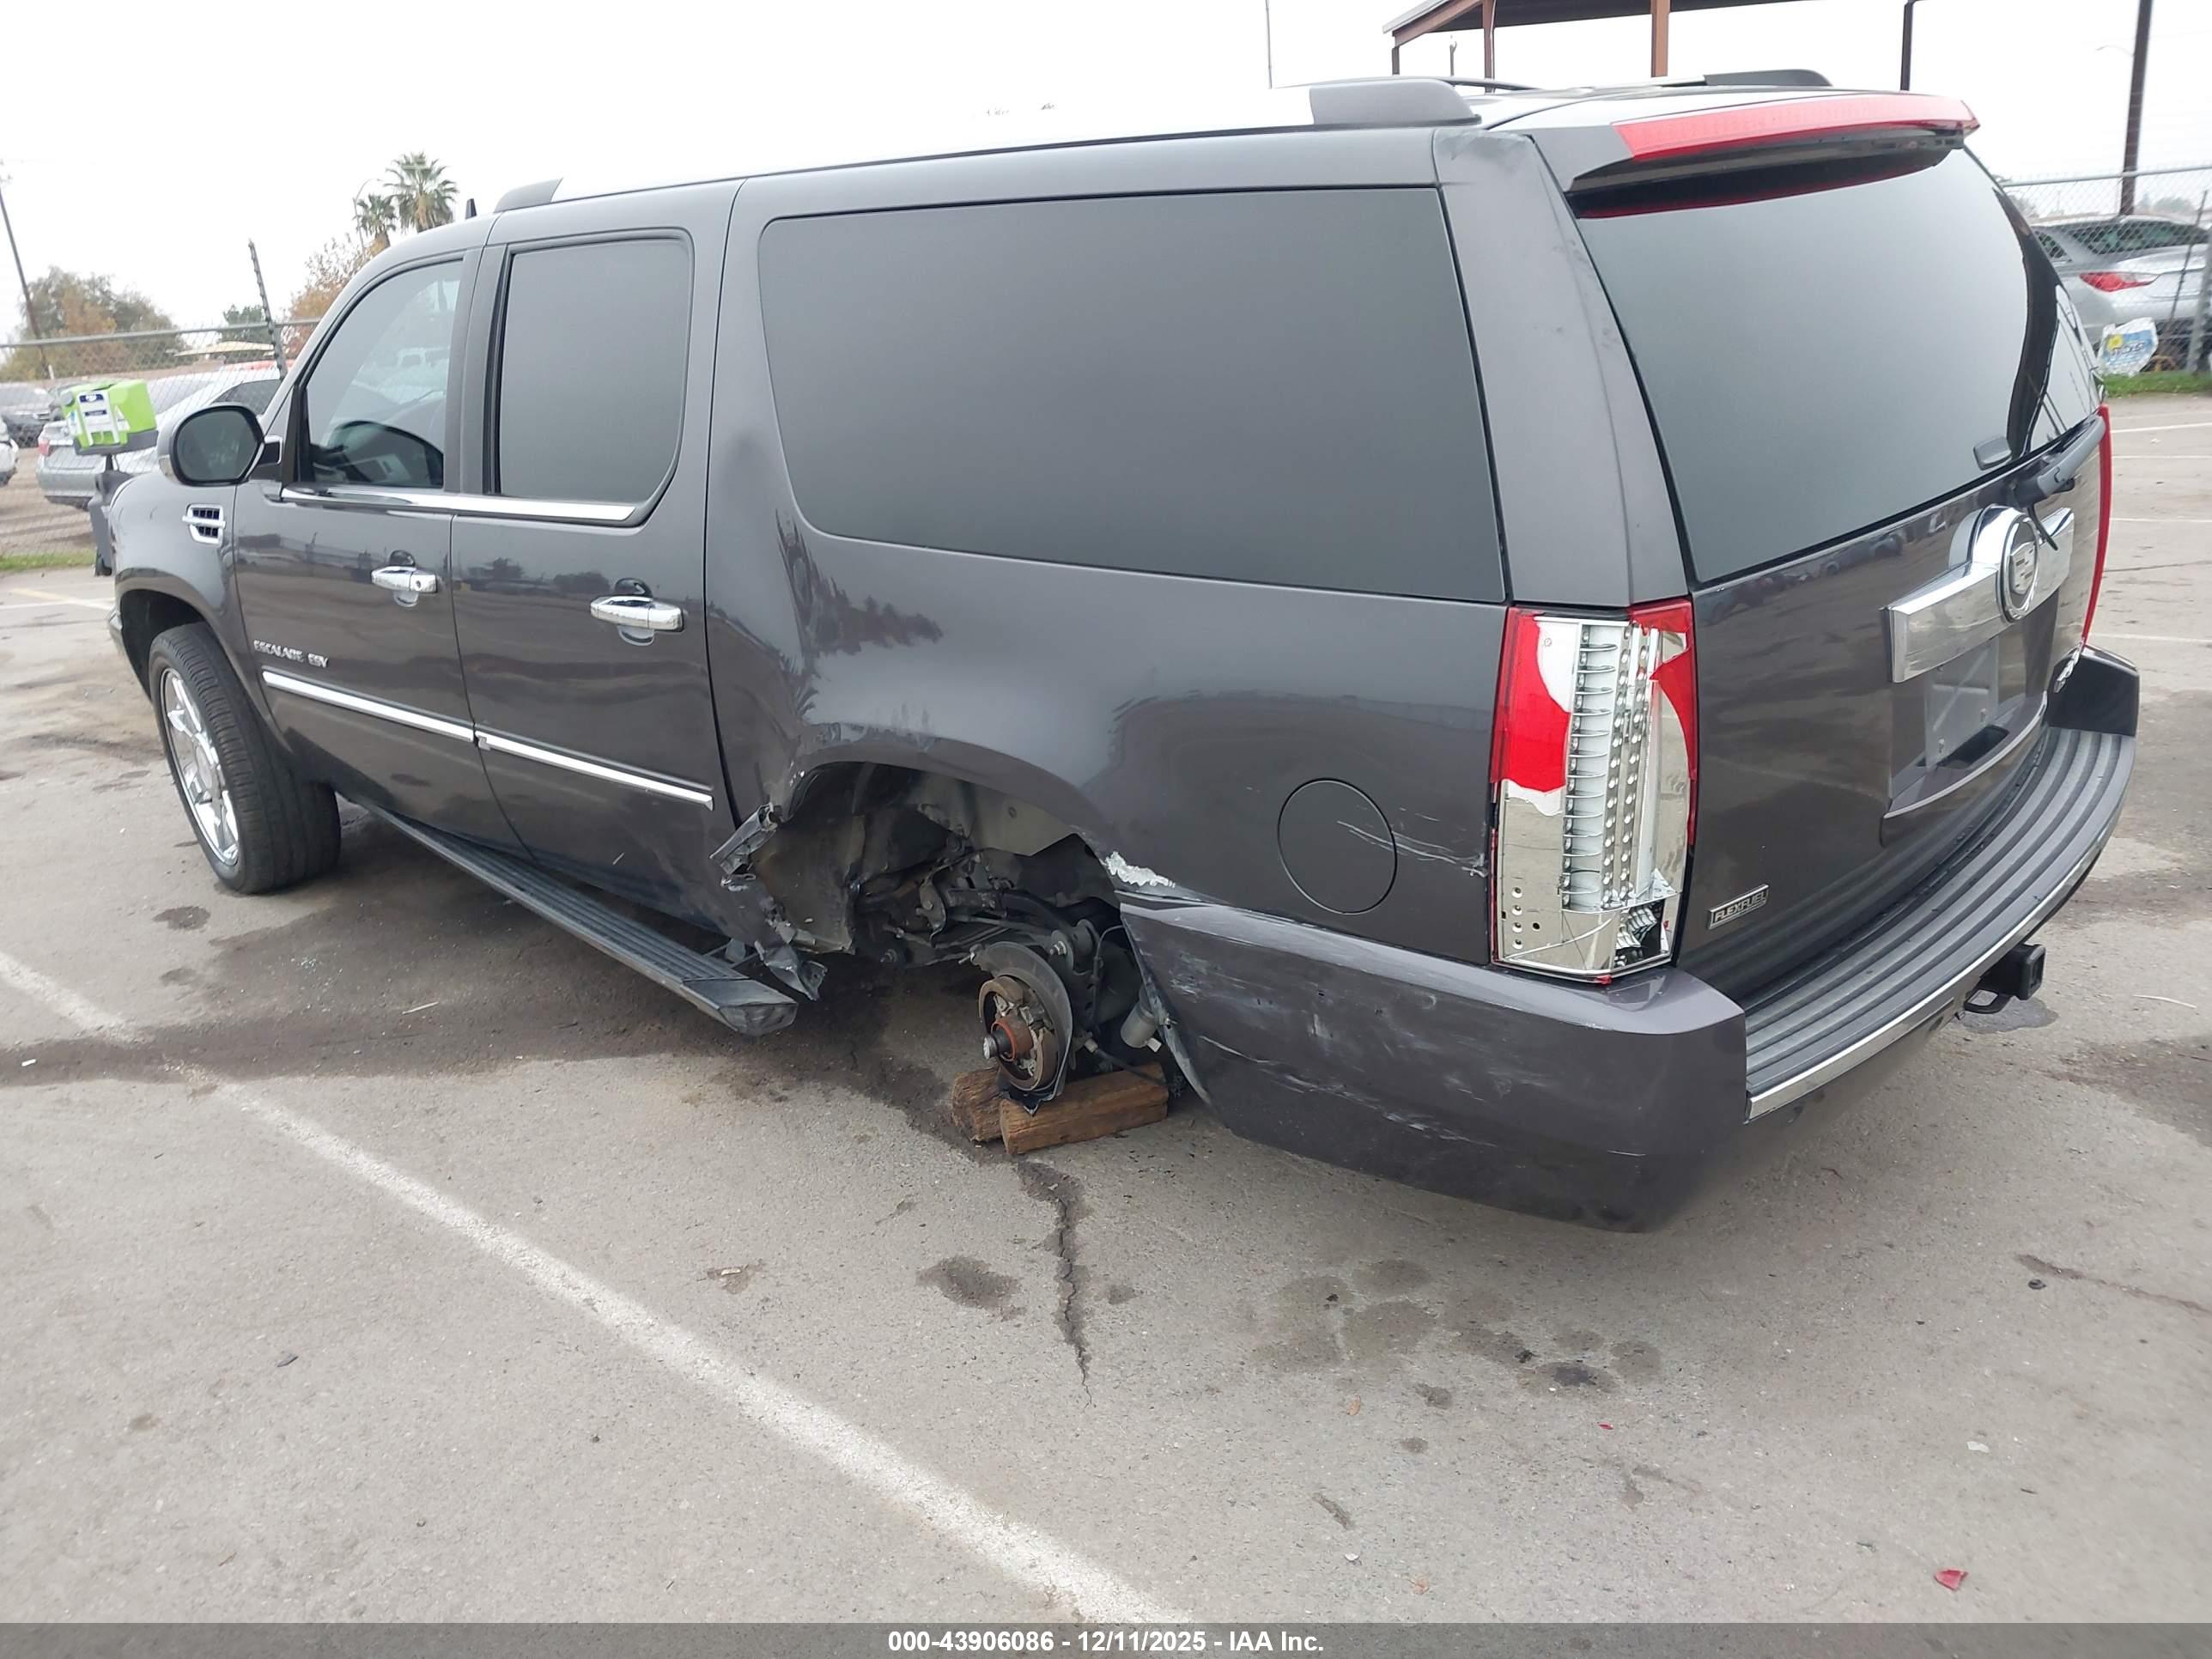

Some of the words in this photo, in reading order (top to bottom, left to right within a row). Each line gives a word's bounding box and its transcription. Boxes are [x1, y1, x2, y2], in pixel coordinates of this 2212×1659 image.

[253, 639, 304, 663] ESCALADE
[307, 653, 329, 668] ESV
[1714, 890, 1766, 923] FLEXFUEL
